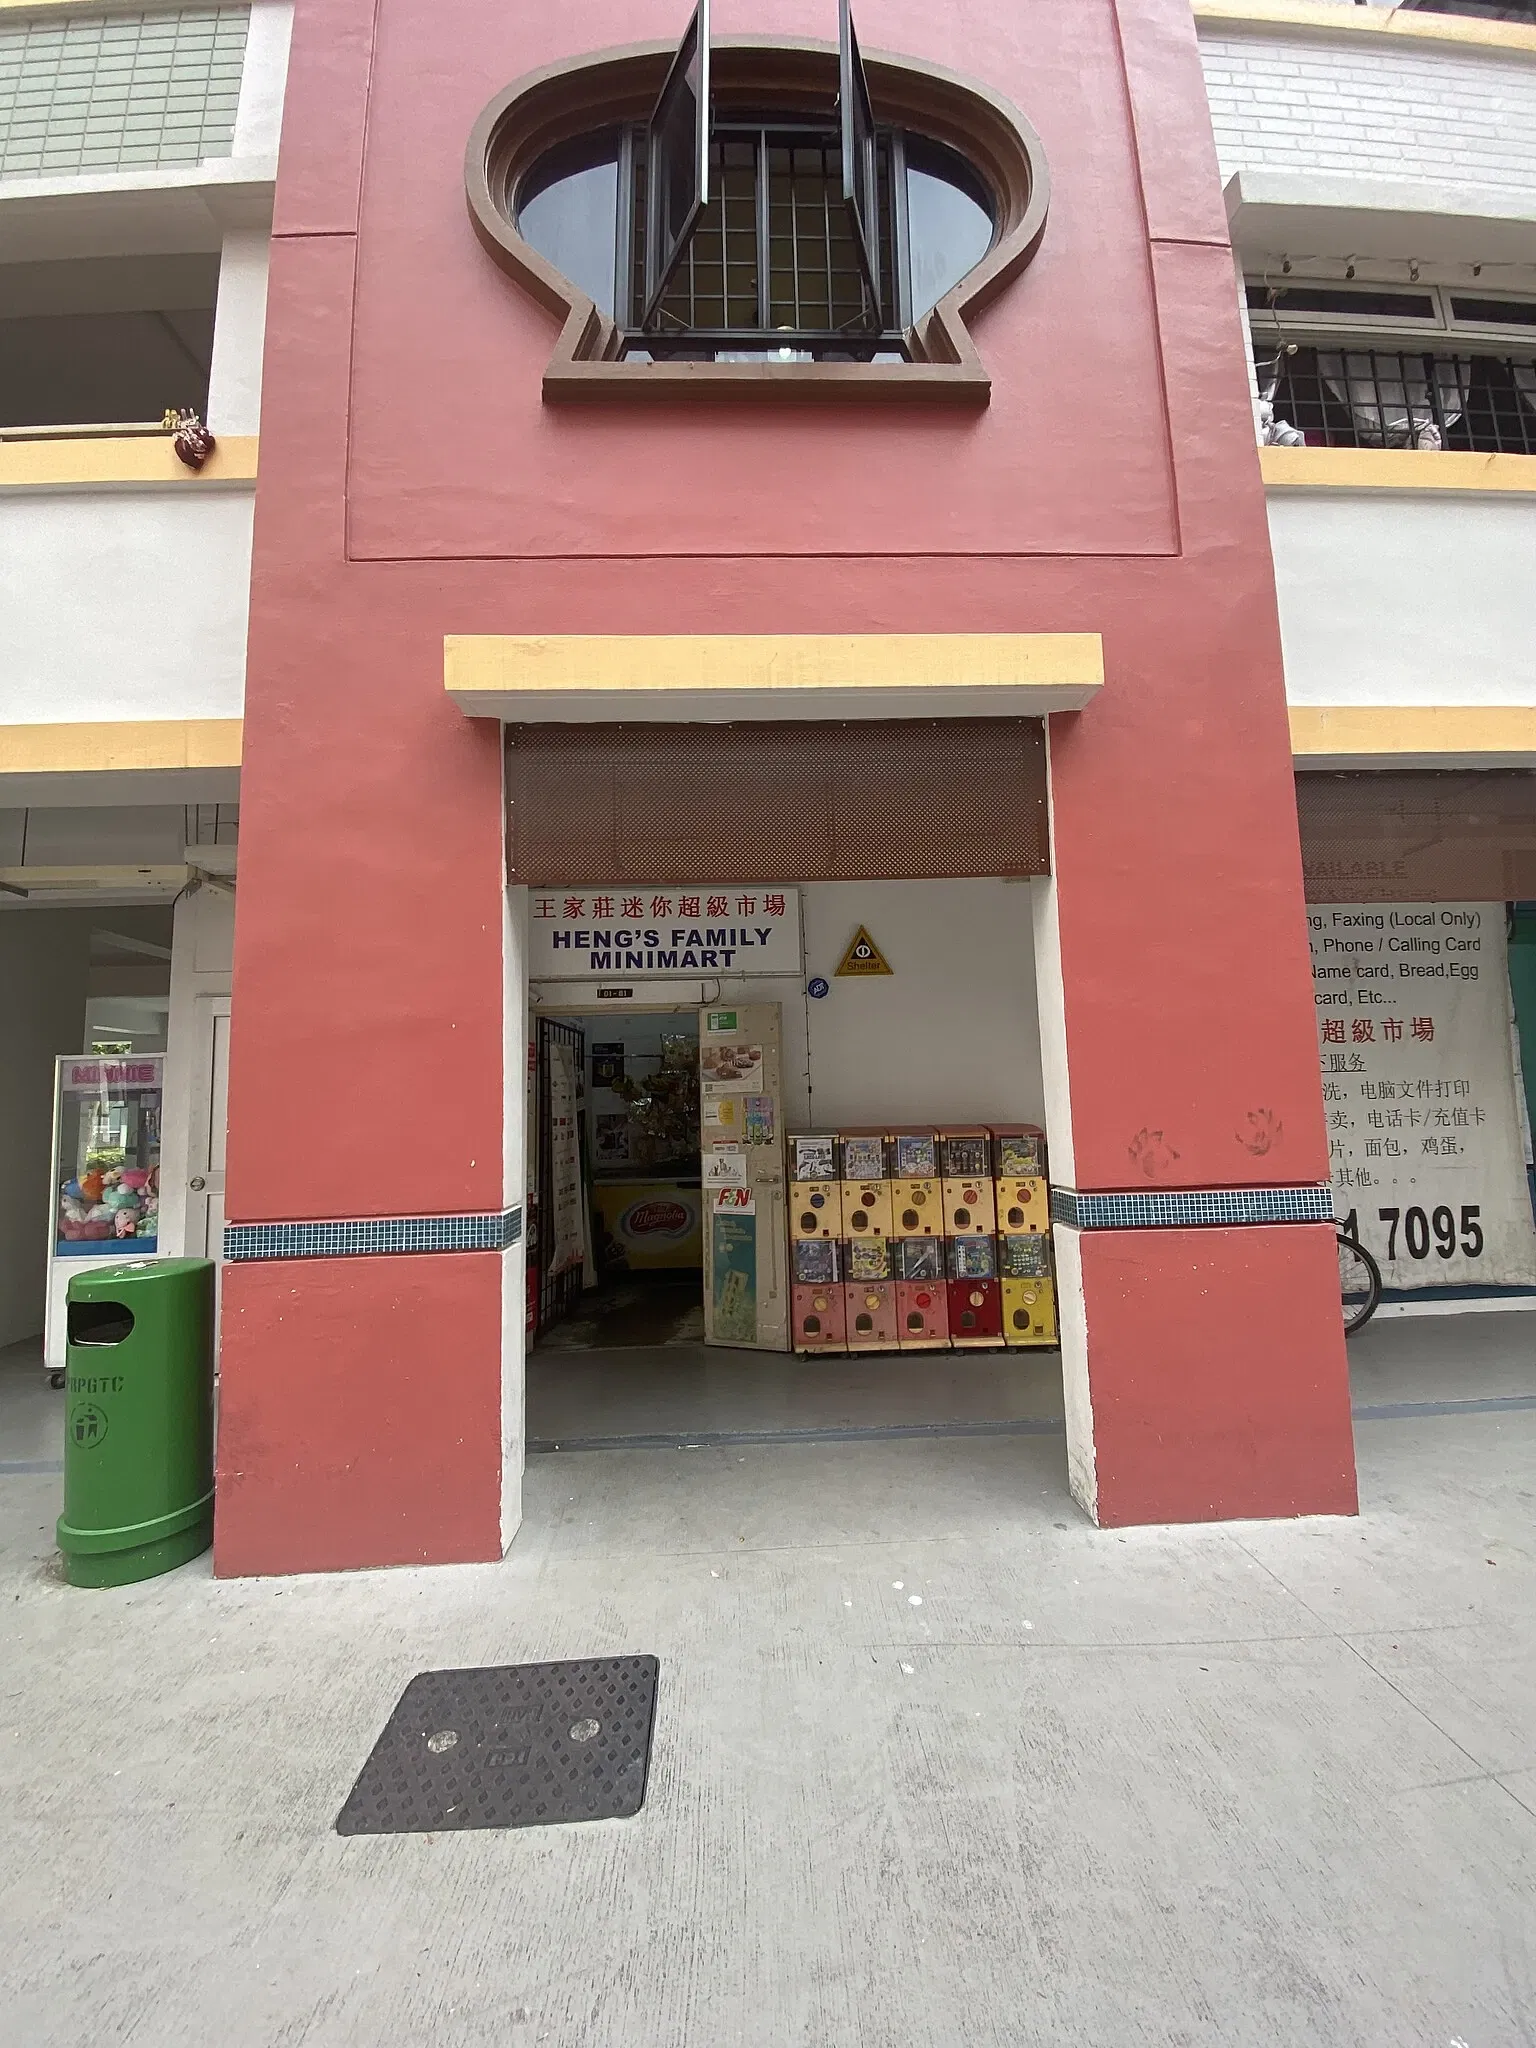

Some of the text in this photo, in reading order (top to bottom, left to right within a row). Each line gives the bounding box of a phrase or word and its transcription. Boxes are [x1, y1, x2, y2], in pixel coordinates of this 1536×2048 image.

[533, 894, 786, 919] 王家莊迷你超級市場
[1332, 912, 1384, 929] Faxing
[1390, 911, 1436, 929] (Local
[1440, 911, 1481, 929] Only)
[553, 927, 772, 949] HENG'S FAMILY
[1324, 938, 1374, 952] Phone
[1378, 938, 1383, 952] /
[1388, 937, 1440, 955] Calling
[1445, 937, 1481, 951] Card
[590, 949, 736, 969] MINIMART
[847, 961, 880, 971] Shelter
[1357, 963, 1394, 979] card,
[1399, 962, 1479, 980] Bread,Egg
[1314, 989, 1397, 1006] card, Etc...
[1321, 1016, 1435, 1044] 超級市場
[634, 1209, 685, 1225] Magnolia
[1378, 1204, 1484, 1260] 7095
